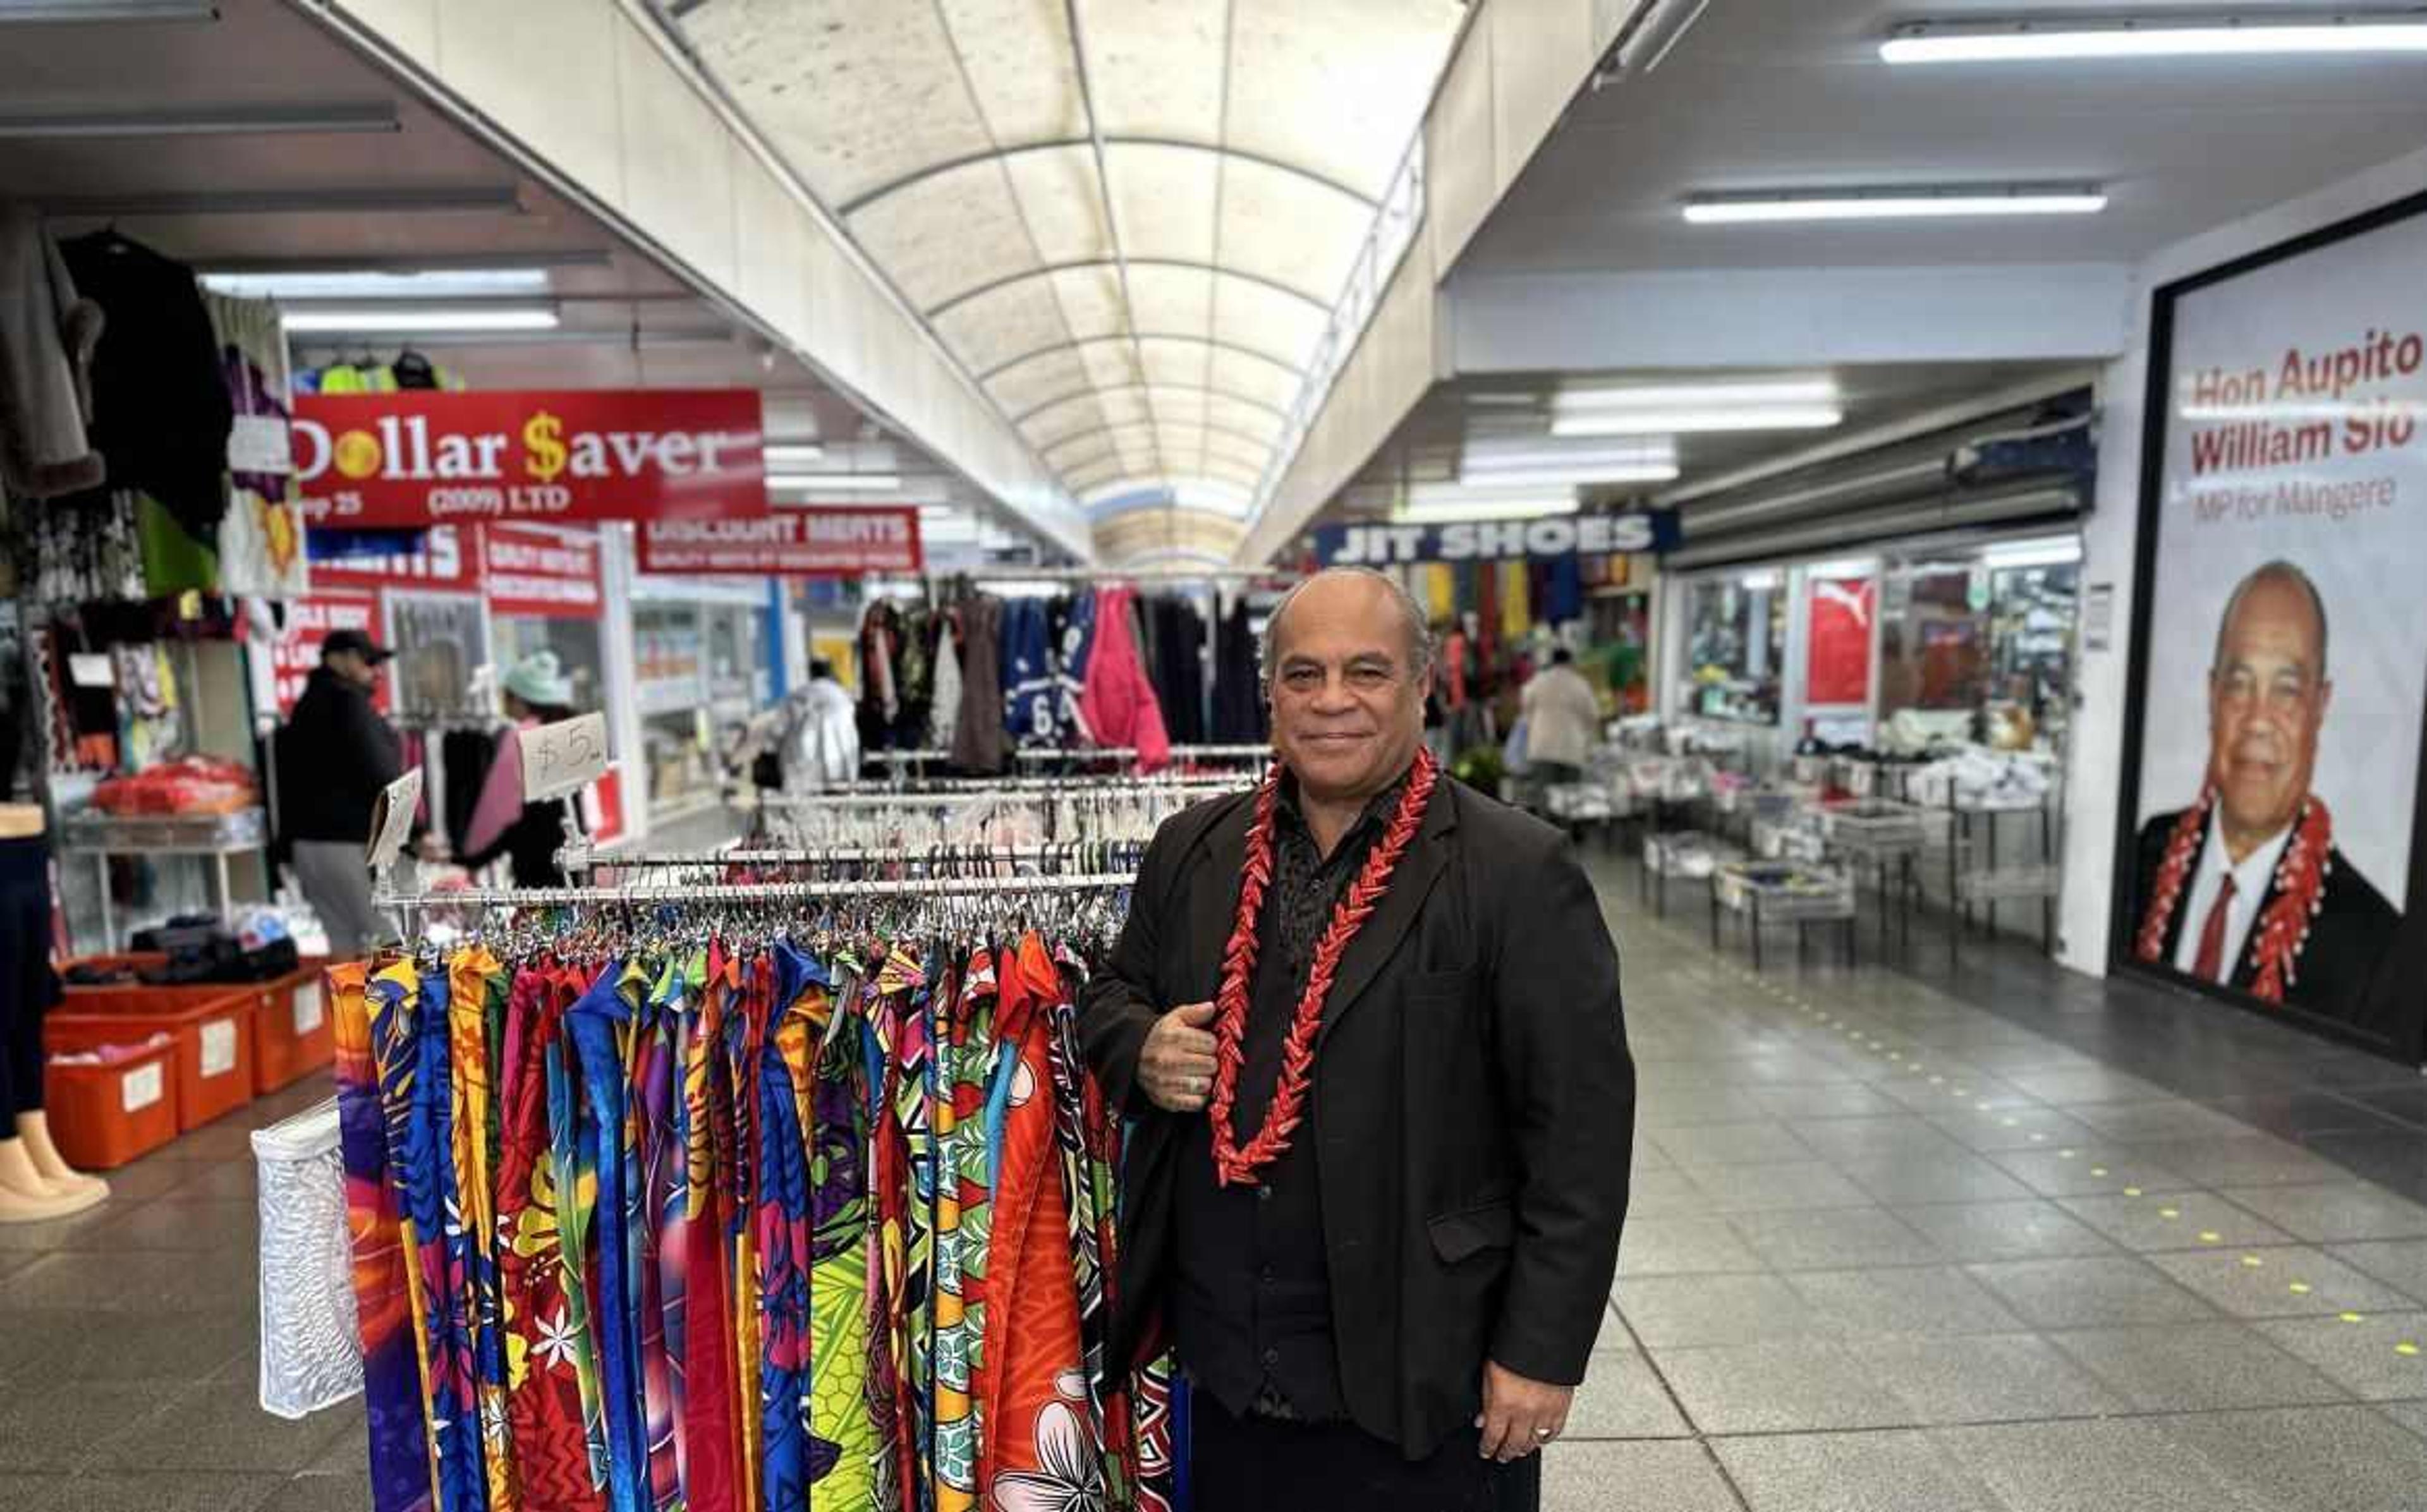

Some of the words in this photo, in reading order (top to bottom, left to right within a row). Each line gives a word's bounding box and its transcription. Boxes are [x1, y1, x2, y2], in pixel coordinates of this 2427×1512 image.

[2194, 366, 2265, 406] Hon
[2278, 329, 2423, 399] Aupito
[292, 415, 508, 481] Dollar
[523, 409, 727, 483] $aver
[2191, 420, 2331, 475] William
[2344, 398, 2415, 453] Sio
[508, 484, 571, 512] LTD
[2194, 490, 2232, 523] MP
[2237, 486, 2271, 520] for
[1333, 526, 1424, 563] JIT
[1439, 514, 1653, 559] SHOES
